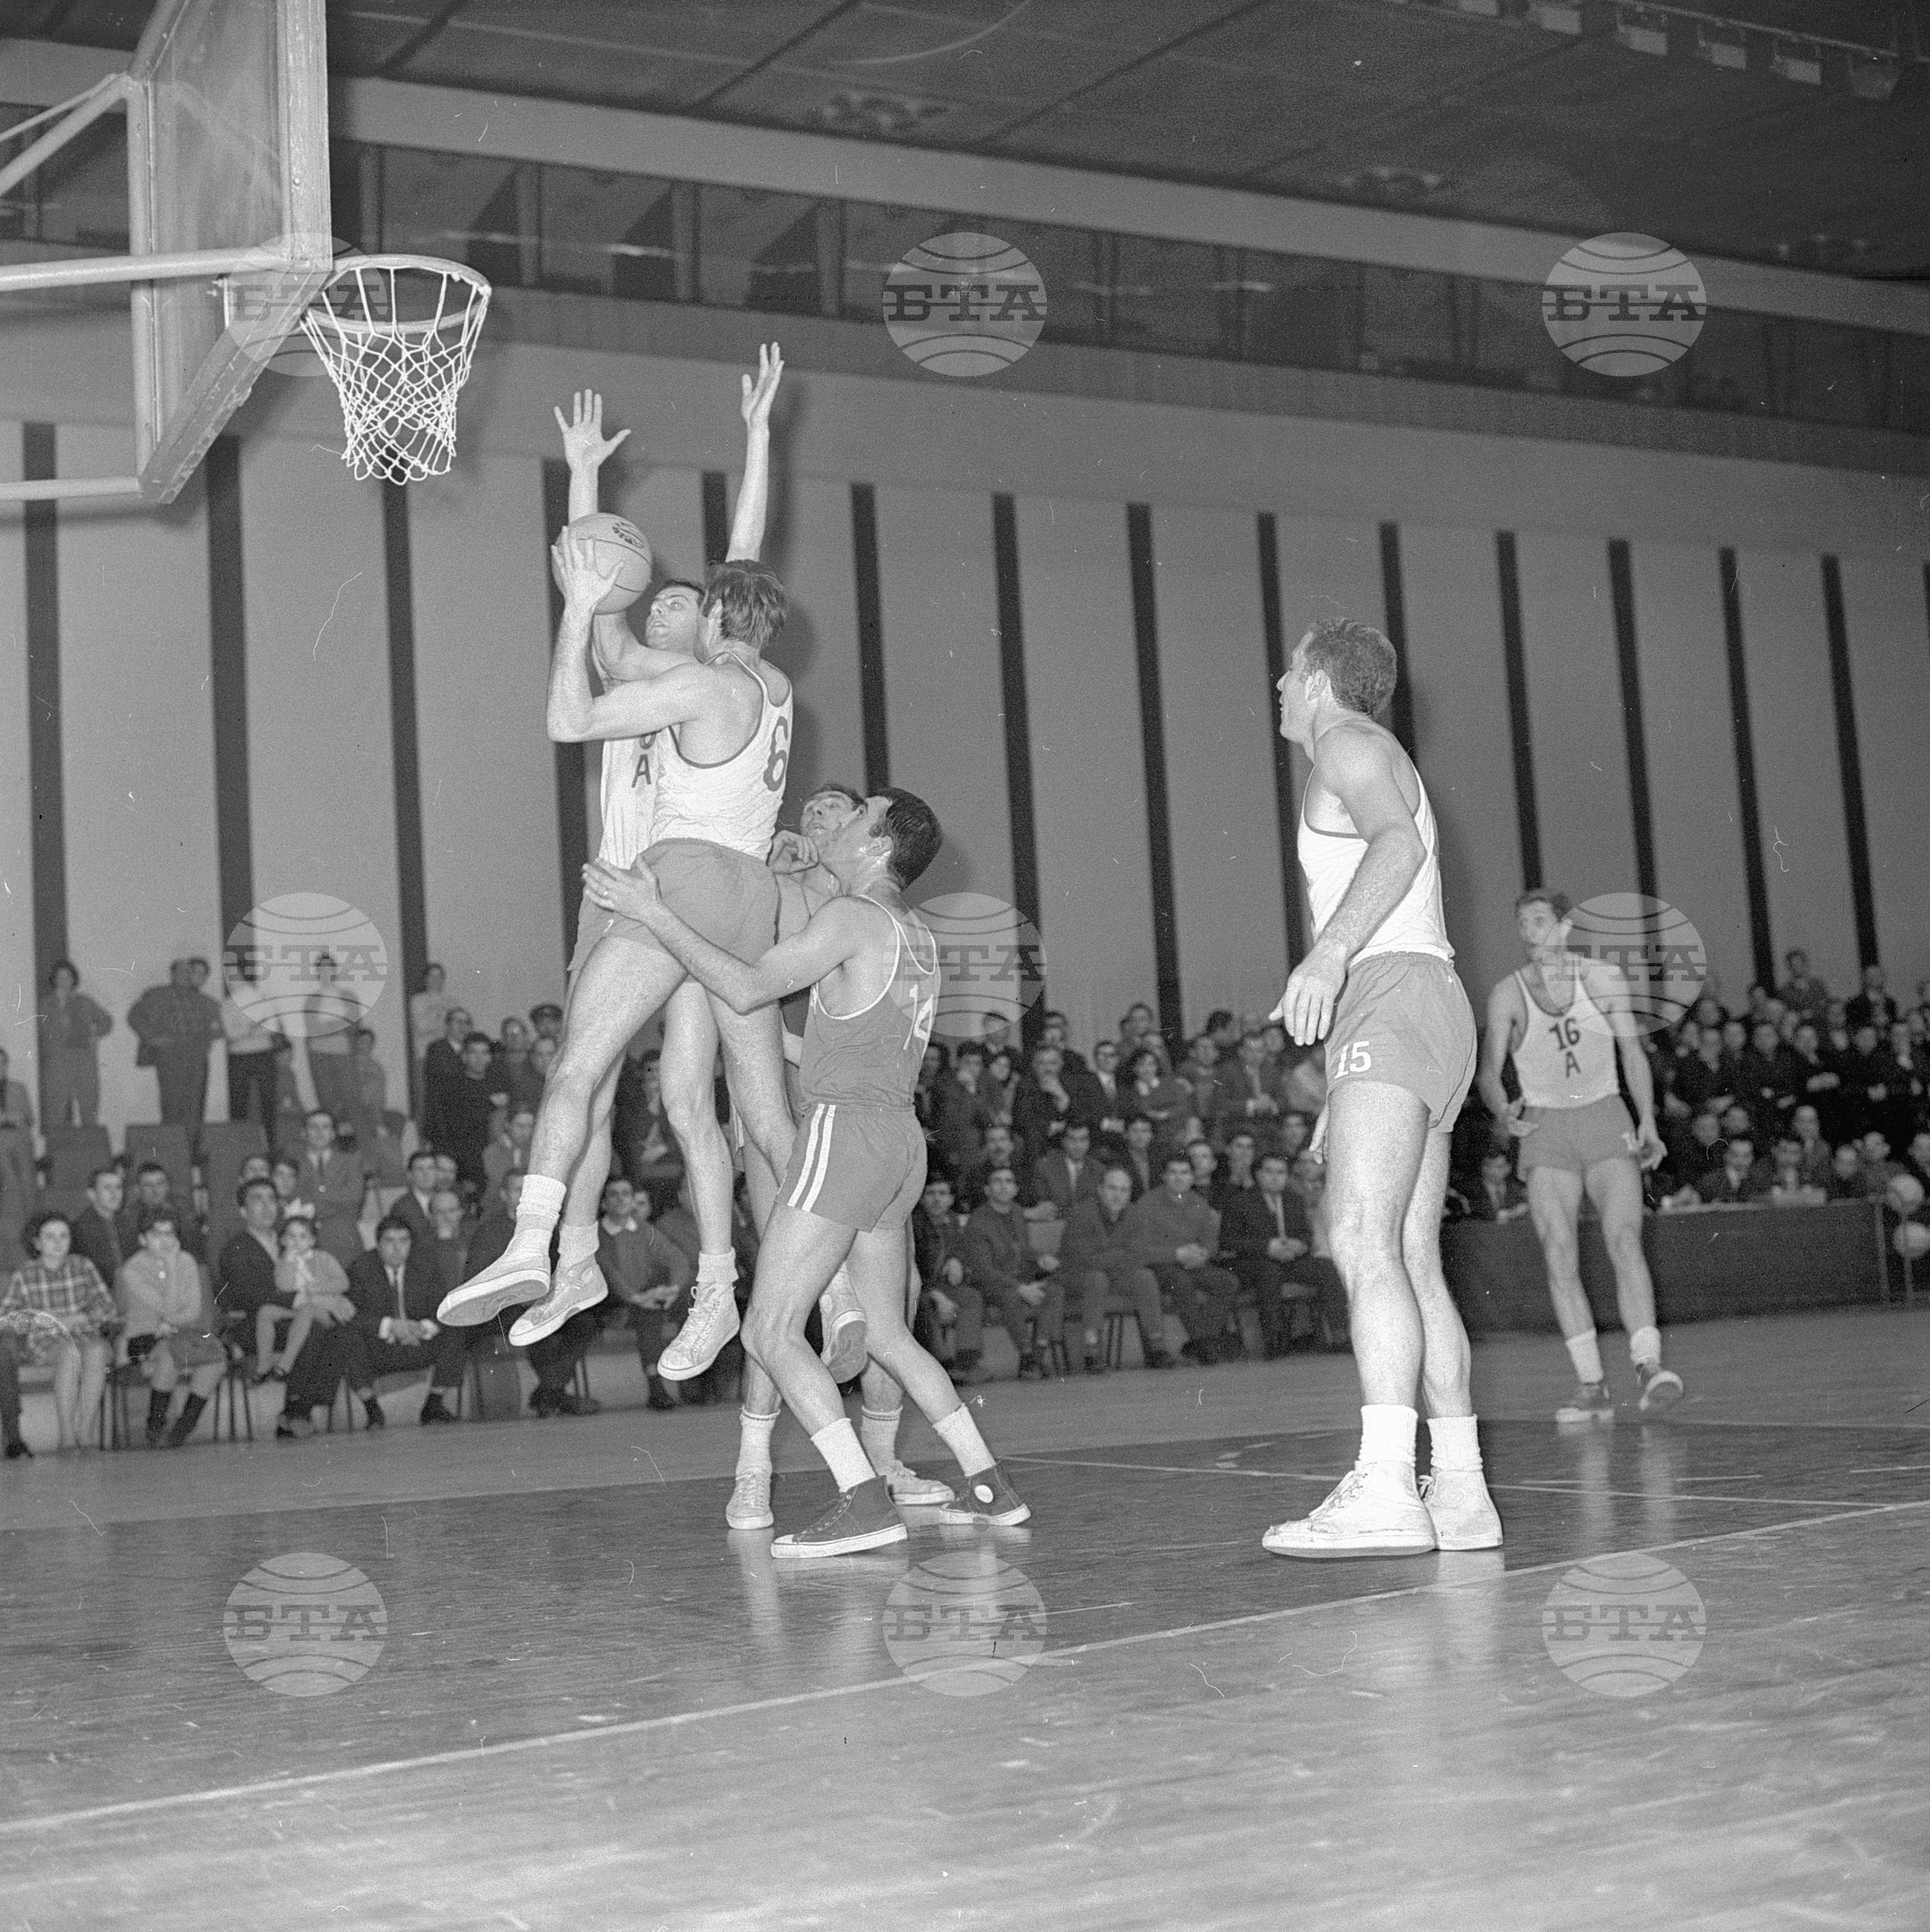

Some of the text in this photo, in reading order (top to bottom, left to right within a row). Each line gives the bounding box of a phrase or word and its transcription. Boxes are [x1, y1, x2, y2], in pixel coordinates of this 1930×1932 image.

[631, 753, 652, 788] A
[763, 716, 789, 792] 6
[1549, 1017, 1580, 1050] 16
[1334, 1040, 1372, 1079] 15
[1566, 1051, 1581, 1078] A
